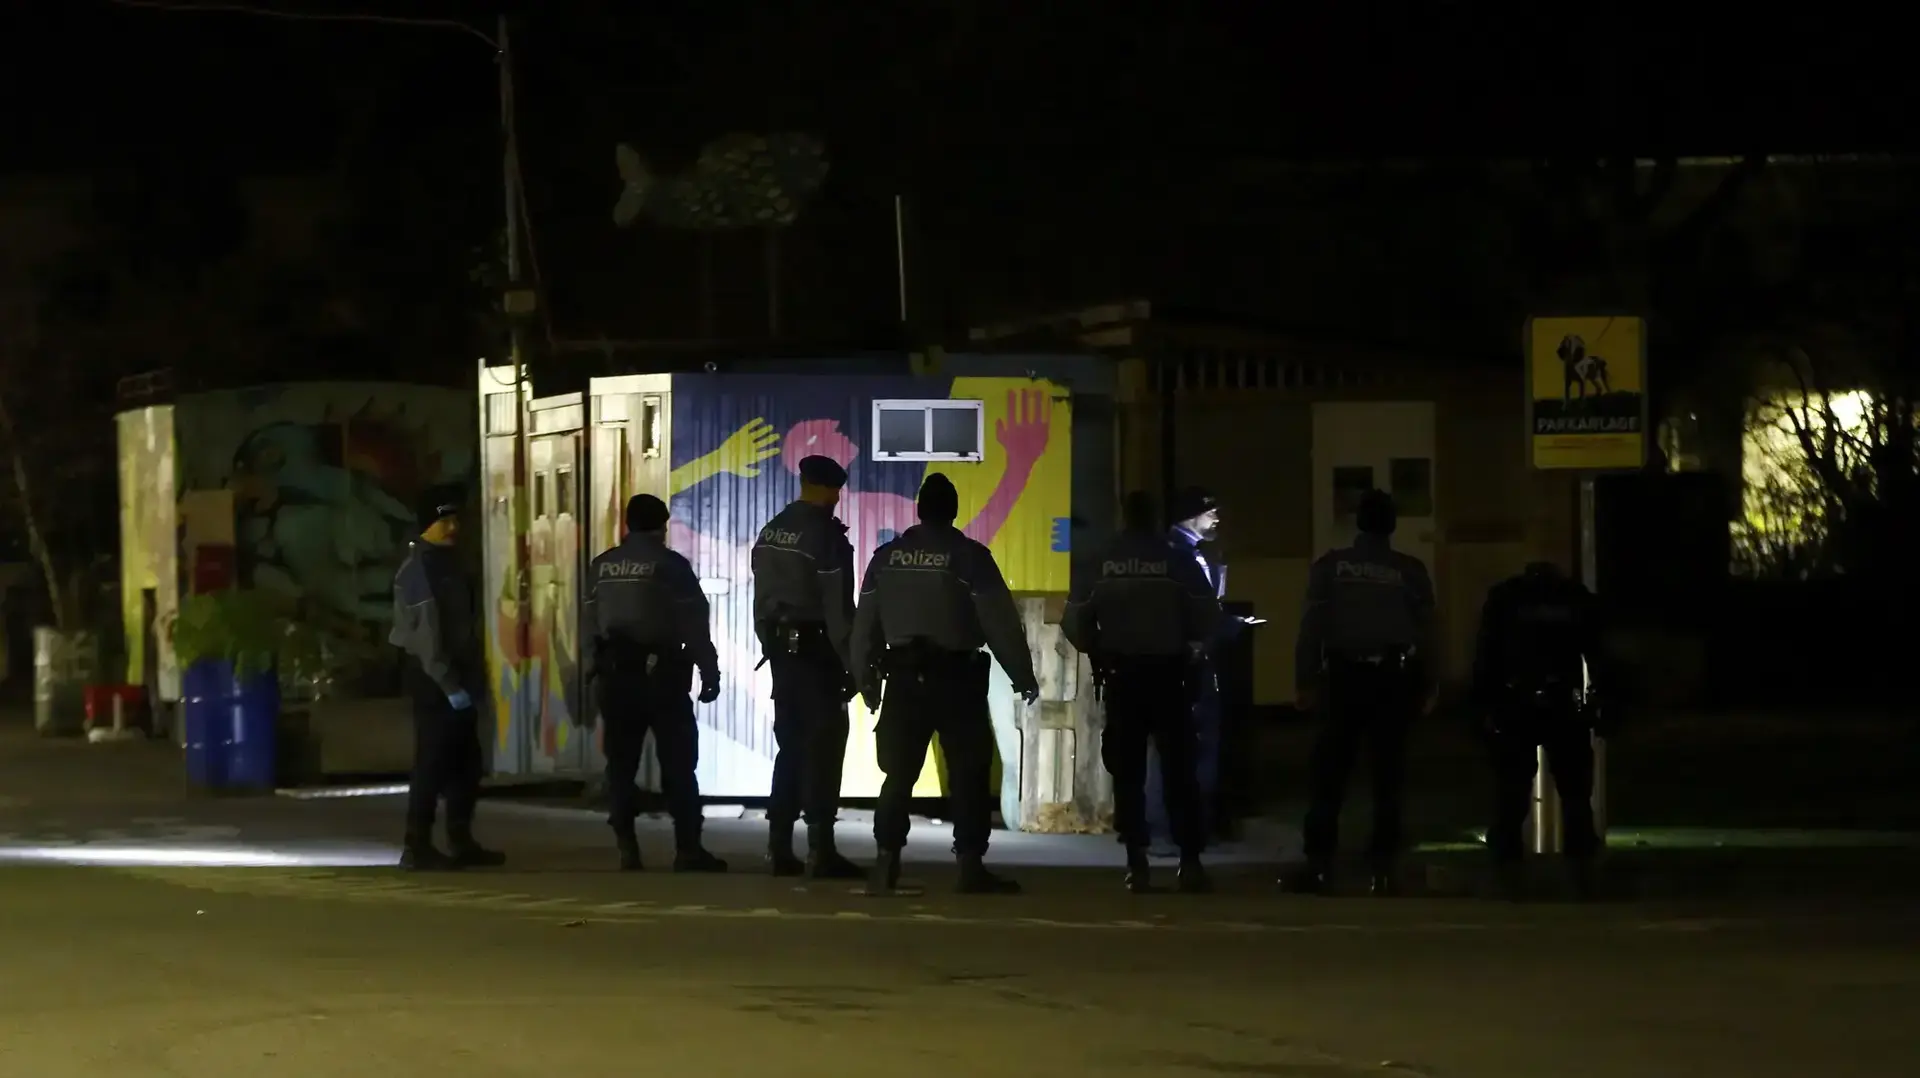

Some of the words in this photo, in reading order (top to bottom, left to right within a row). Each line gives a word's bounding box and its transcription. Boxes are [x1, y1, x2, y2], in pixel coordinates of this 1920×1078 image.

[599, 557, 657, 577] Polizei
[888, 547, 952, 568] Polizei
[1102, 557, 1168, 577] Polizei
